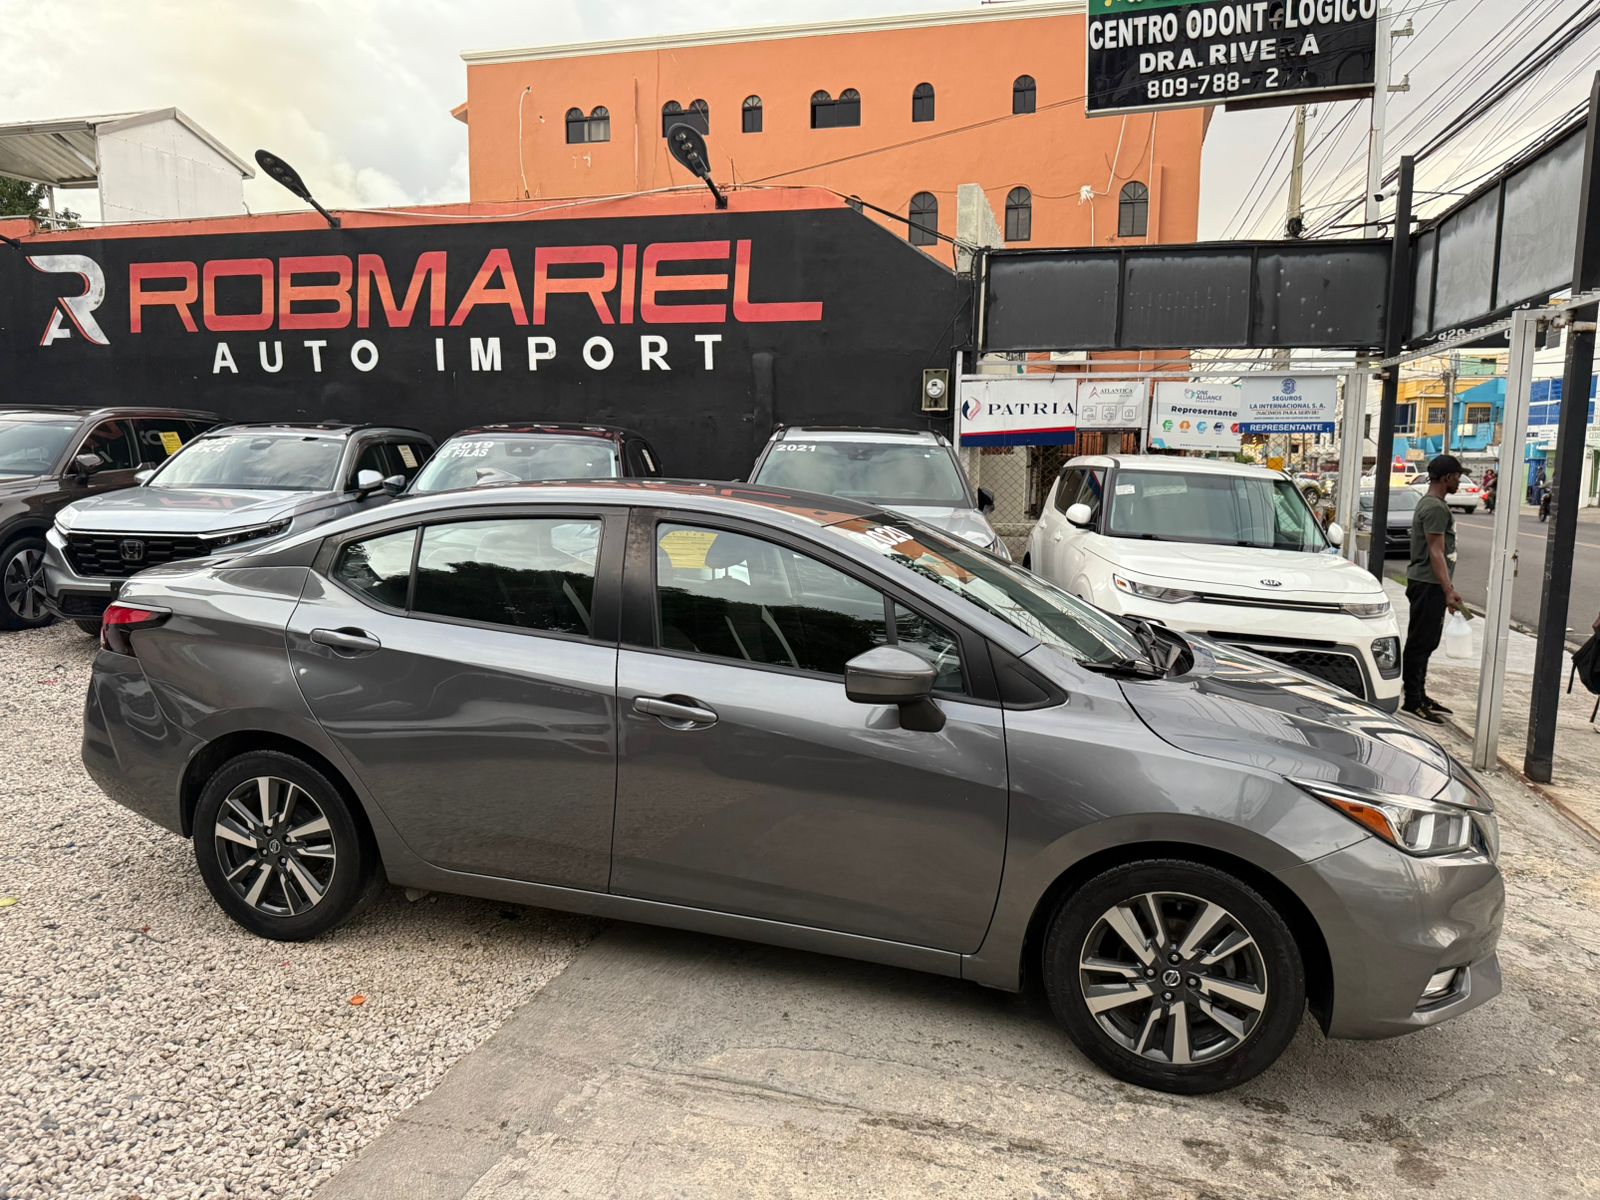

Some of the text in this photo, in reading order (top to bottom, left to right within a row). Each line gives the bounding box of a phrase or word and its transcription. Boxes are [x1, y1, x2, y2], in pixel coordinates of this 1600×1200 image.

[1089, 0, 1376, 50] CENTRO ODONTLOGICO
[1139, 48, 1204, 74] DRA.
[129, 239, 823, 333] ROBMARIEL
[212, 333, 723, 374] AUTO IMPORT
[988, 402, 1078, 416] PATRIA
[1170, 405, 1238, 418] Representante
[1249, 423, 1323, 432] REPRESENTANTE
[451, 441, 494, 449] 2019
[776, 444, 817, 452] 2021
[452, 448, 489, 458] FILAS
